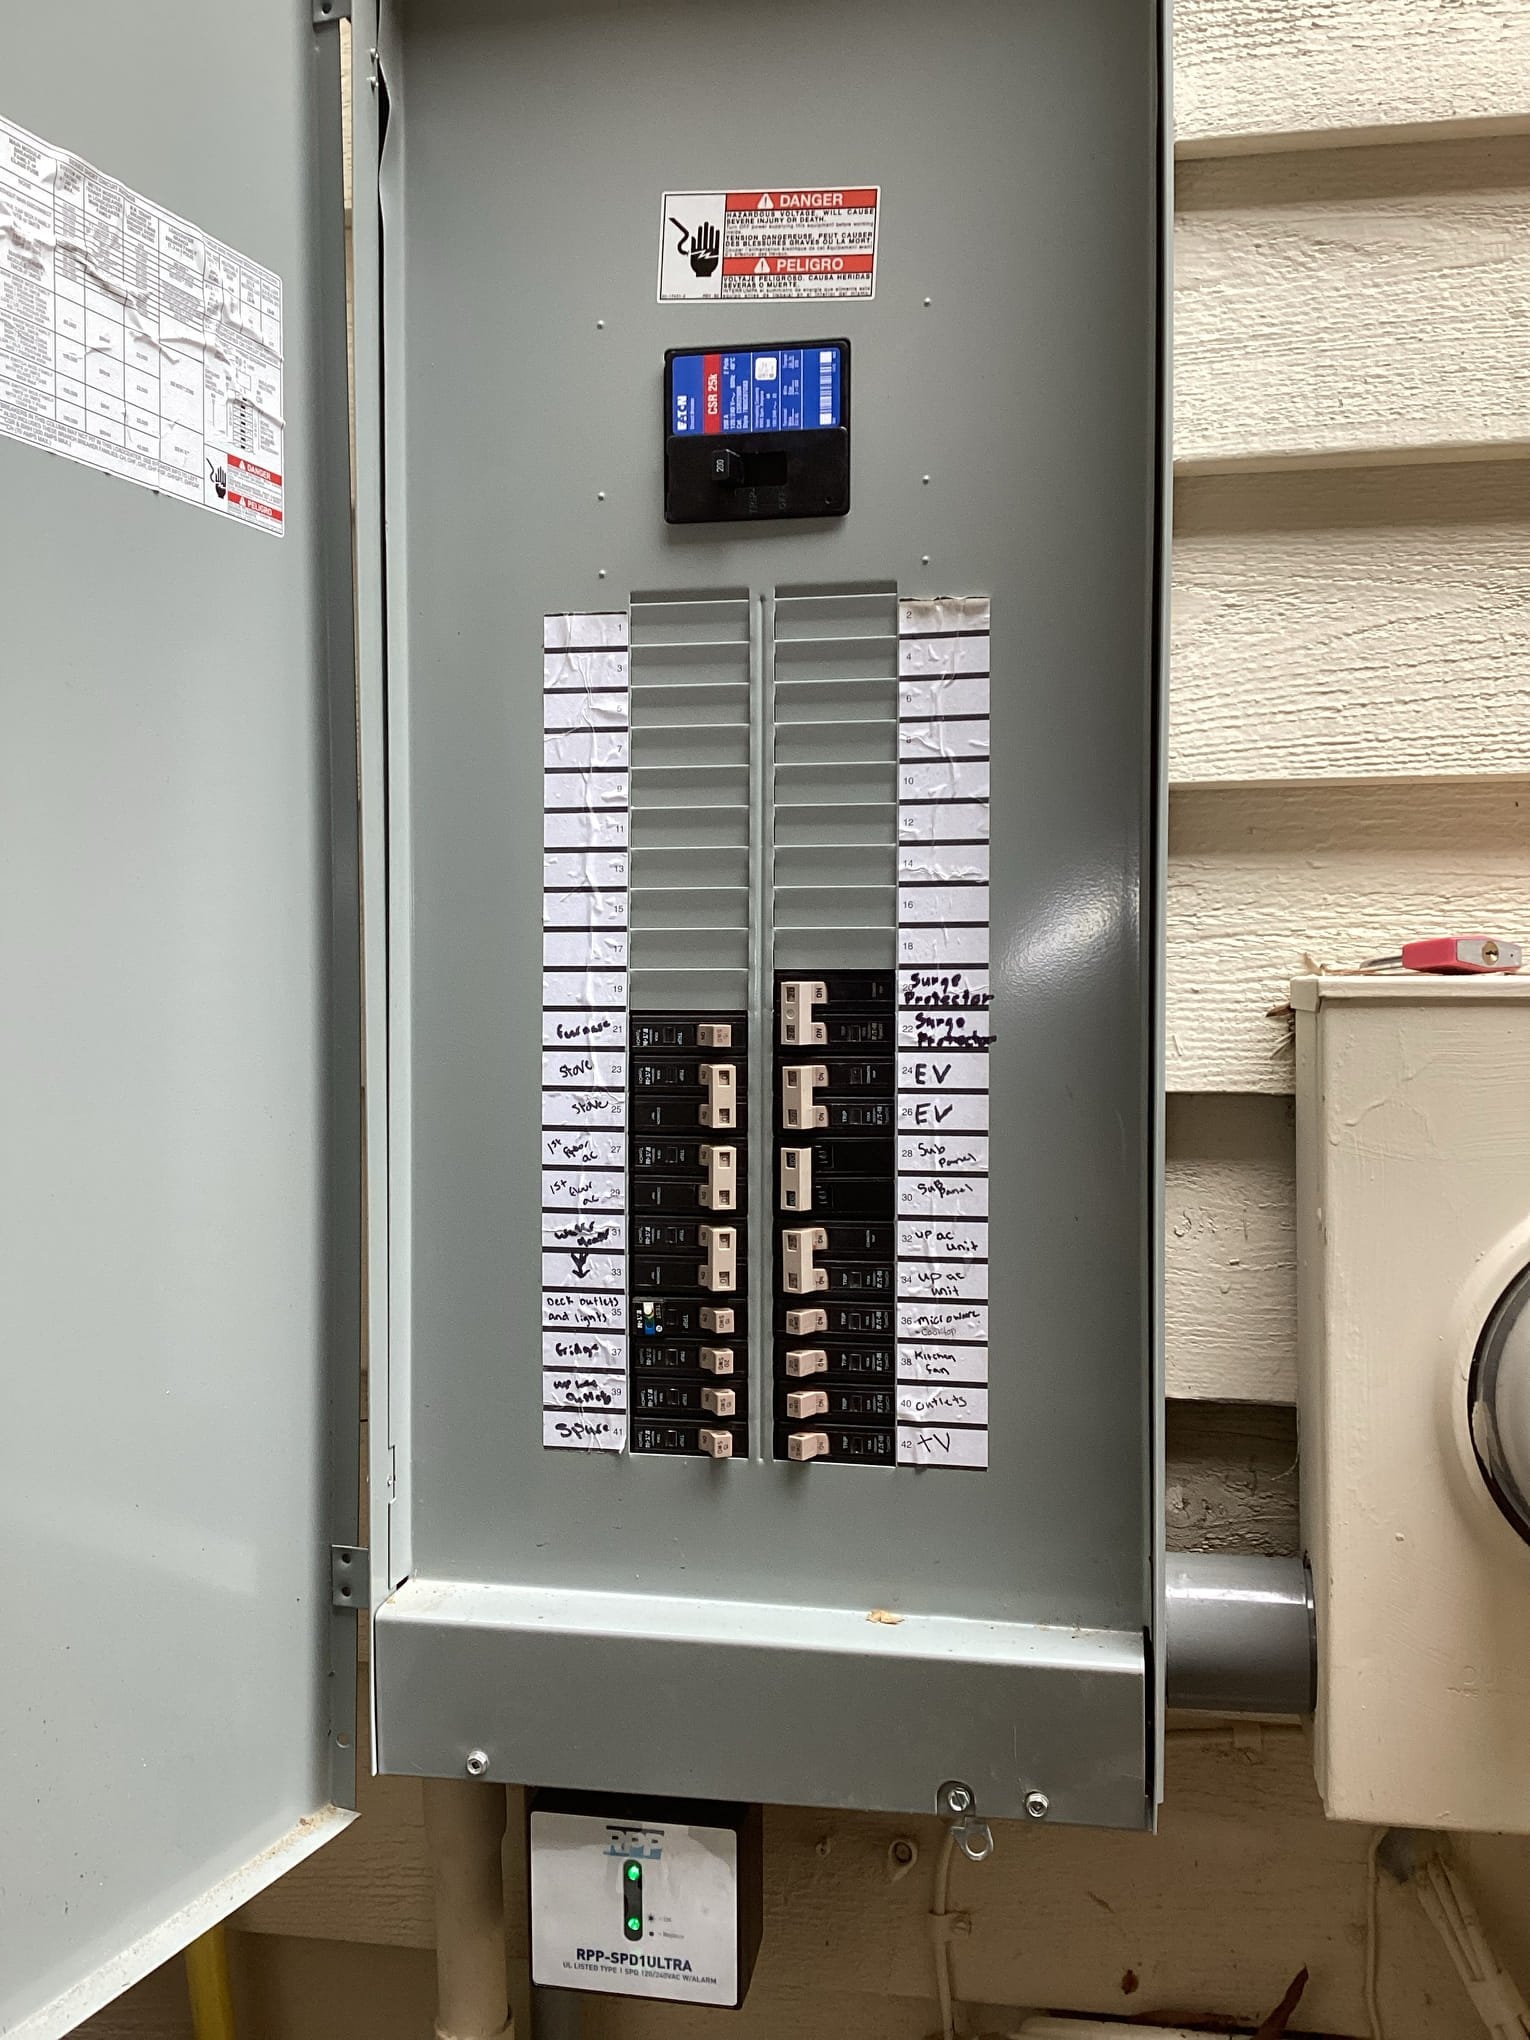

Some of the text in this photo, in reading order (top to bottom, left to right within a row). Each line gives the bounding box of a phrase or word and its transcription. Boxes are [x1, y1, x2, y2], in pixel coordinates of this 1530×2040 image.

[780, 193, 843, 208] DANGER
[777, 258, 844, 272] PELIGRO
[707, 374, 718, 415] CSR 25k
[677, 395, 687, 430] EATON
[716, 459, 724, 473] 200
[247, 464, 271, 480] DANGER
[247, 501, 272, 515] PELIGRO
[906, 611, 912, 619] 2
[618, 624, 622, 632] 1
[617, 664, 623, 672] 3
[617, 704, 623, 712] 5
[904, 777, 914, 785] 10
[617, 785, 623, 793] 9
[615, 825, 624, 833] 11
[614, 865, 624, 873] 13
[614, 905, 624, 913] 15
[903, 901, 913, 909] 16
[613, 945, 623, 953] 17
[911, 973, 962, 995] Surge
[613, 985, 623, 993] 19
[816, 987, 822, 998] ON
[915, 1012, 965, 1036] Surge
[613, 1025, 622, 1033] 21
[902, 1025, 913, 1033] 22
[816, 1028, 823, 1039] ON
[560, 1060, 593, 1078] Stove
[611, 1065, 622, 1073] 23
[902, 1067, 913, 1075] 24
[915, 1063, 952, 1084] EV
[572, 1100, 609, 1114] Stove
[611, 1105, 622, 1113] 25
[902, 1108, 913, 1116] 26
[915, 1103, 953, 1125] EV
[610, 1145, 621, 1153] 27
[918, 1142, 946, 1157] Sub
[611, 1228, 621, 1236] 31
[902, 1235, 912, 1243] 32
[946, 1240, 979, 1252] unit
[901, 1276, 912, 1284] 34
[931, 1285, 960, 1297] unit
[547, 1296, 574, 1306] Deck
[611, 1308, 622, 1316] 35
[549, 1312, 607, 1327] and lights
[817, 1316, 824, 1326] ON
[901, 1317, 912, 1325] 36
[611, 1348, 622, 1356] 37
[723, 1359, 730, 1368] 20
[901, 1358, 912, 1366] 38
[611, 1388, 622, 1396] 39
[901, 1400, 911, 1408] 40
[613, 1428, 623, 1436] 41
[576, 1948, 692, 1972] RPP-SPD1ULTRA
[574, 1963, 598, 1972] LISTED
[600, 1965, 617, 1974] TYPE
[683, 1975, 717, 1984] W/ALARM
